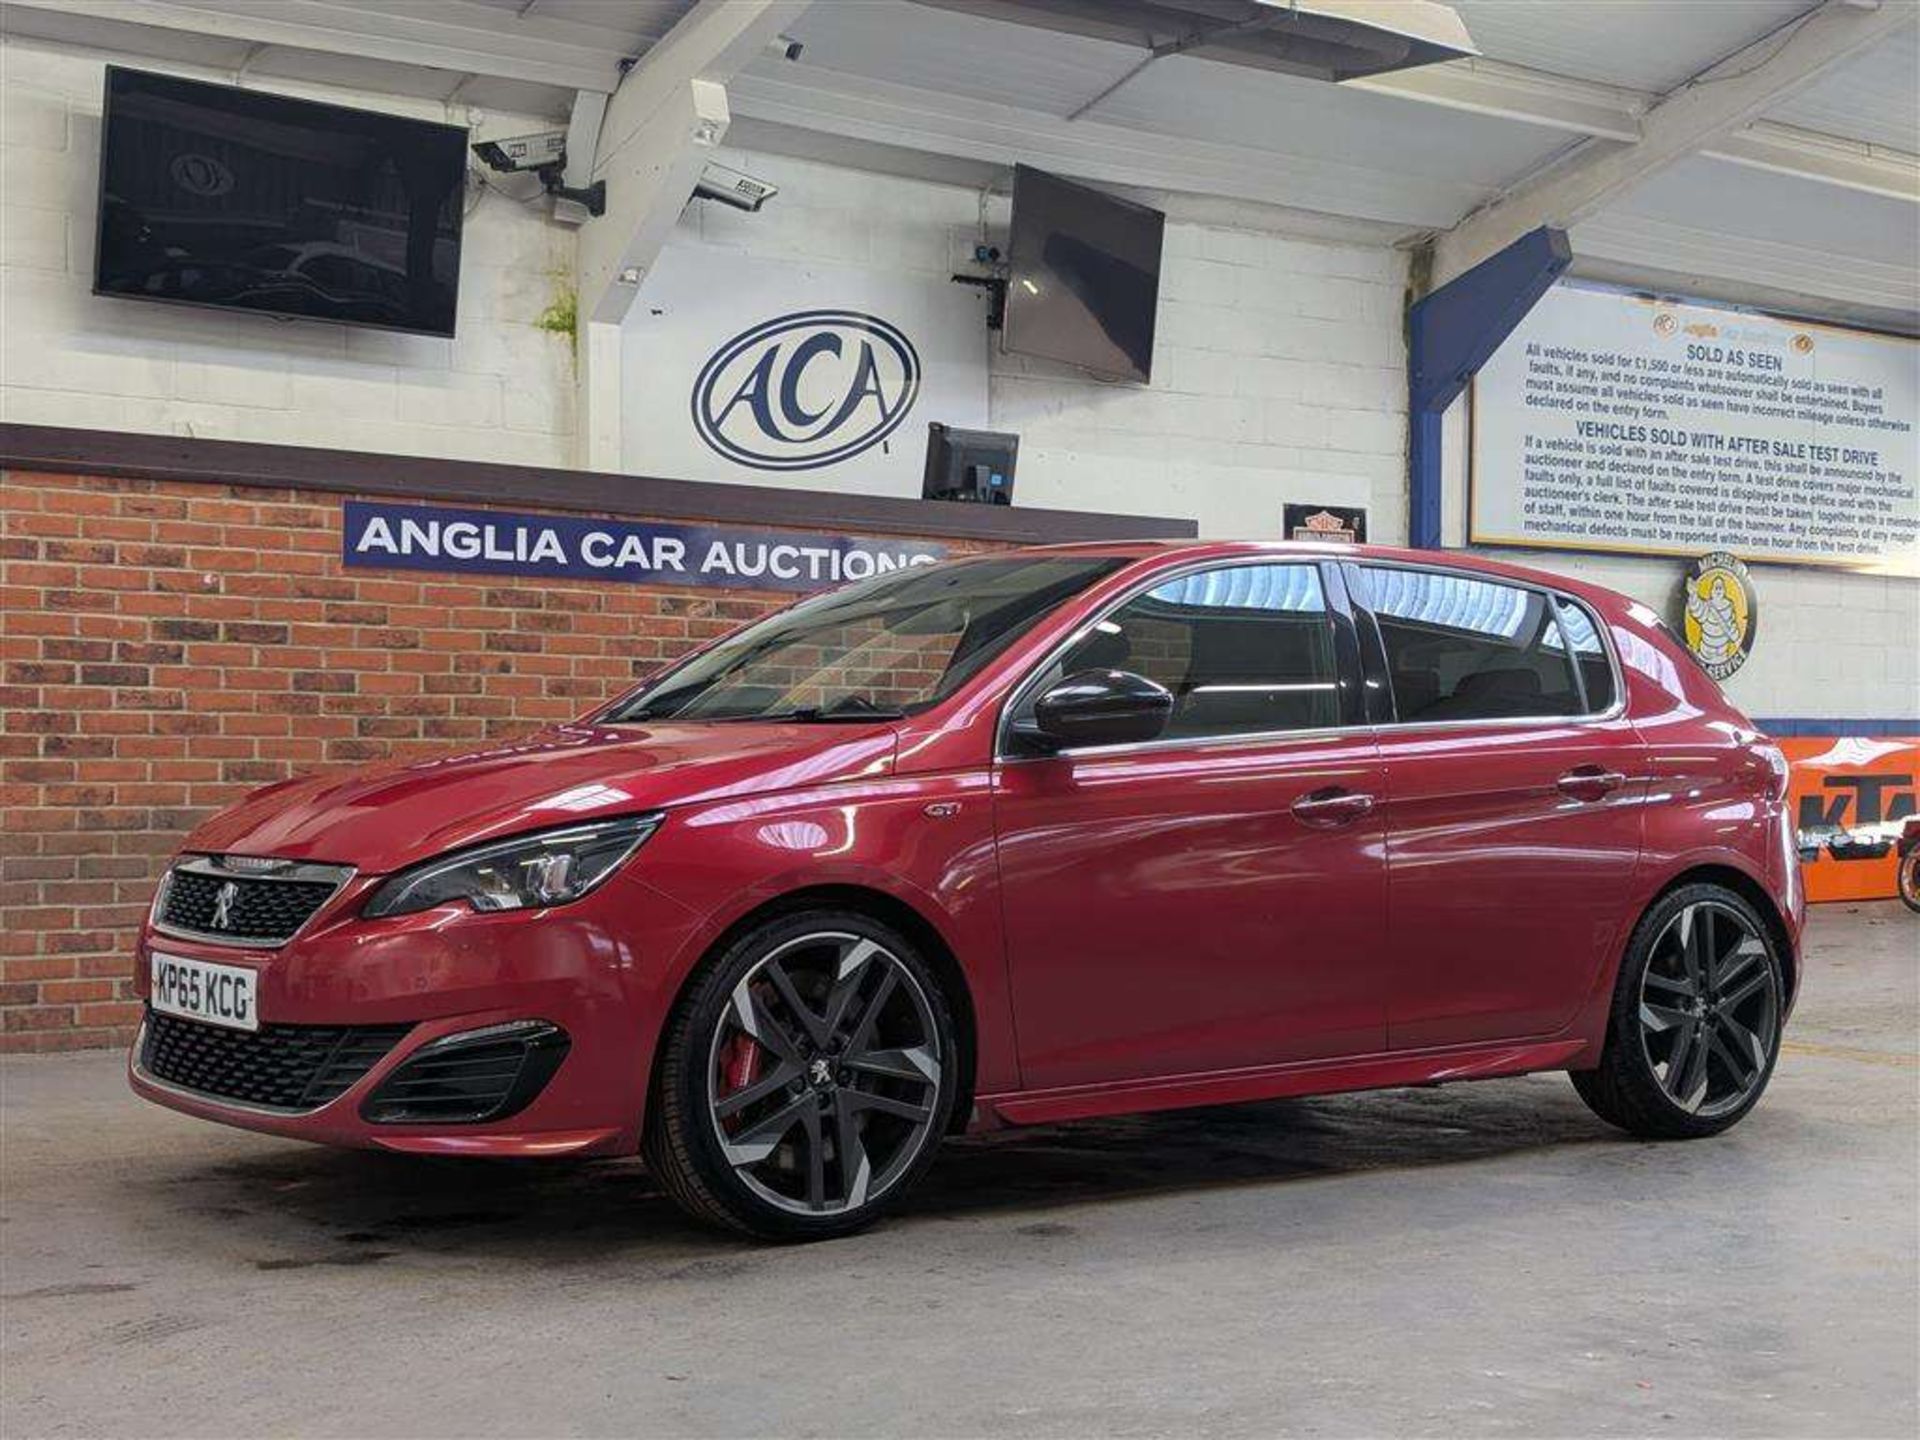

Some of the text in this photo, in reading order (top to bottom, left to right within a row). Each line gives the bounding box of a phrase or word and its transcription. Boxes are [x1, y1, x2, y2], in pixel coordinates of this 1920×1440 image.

[1526, 344, 1540, 356] All
[1544, 345, 1588, 363] vehicles
[1591, 353, 1615, 366] sold
[1617, 356, 1632, 367] for
[1671, 363, 1682, 373] or
[1684, 363, 1705, 377] less
[1707, 368, 1723, 379] are
[1725, 370, 1789, 390] automatically
[1791, 379, 1812, 391] sold
[1814, 383, 1825, 393] as
[1828, 384, 1848, 395] seen
[1851, 386, 1870, 398] with
[1872, 388, 1882, 399] all
[1687, 344, 1782, 371] SOLD AS SEEN
[712, 331, 889, 443] ACA
[1526, 379, 1911, 432] must assume all vehicles sold as seen have incorrect mileage unless otherwise
[1526, 394, 1669, 420] declared on the entry form.
[1529, 361, 1883, 414] faults, if any, and no complaints whatsoever shall be entertained. Buyers
[1525, 435, 1533, 447] If
[1535, 438, 1542, 447] a
[1545, 439, 1583, 452] vehicle
[1587, 443, 1596, 454] is
[1600, 444, 1622, 456] sold
[1625, 447, 1647, 458] with
[1650, 450, 1662, 460] an
[1665, 450, 1687, 462] after
[1691, 453, 1711, 465] sale
[1713, 455, 1733, 466] test
[1764, 459, 1782, 472] this
[1785, 461, 1808, 474] shall
[1809, 463, 1822, 475] be
[1824, 466, 1873, 481] announced
[1875, 471, 1886, 484] by
[1887, 472, 1902, 484] the
[1576, 420, 1878, 467] VEHICLES SOLD WITH AFTER SALE TEST DRIVE
[1525, 454, 1914, 499] auctioneer and declared on the entry form. A test drive covers major mechanical
[1525, 469, 1892, 512] faults only, a full list of faults covered is displayed in the office and with the
[1524, 486, 1590, 502] auctioneer's
[1593, 491, 1622, 505] clerk.
[1626, 493, 1645, 506] The
[1648, 496, 1671, 508] after
[1674, 498, 1694, 511] sale
[1697, 500, 1716, 512] test
[1718, 501, 1743, 514] drive
[1746, 504, 1769, 515] must
[1772, 505, 1783, 517] be
[1818, 510, 1856, 524] together
[1858, 512, 1877, 524] with
[1879, 515, 1885, 525] a
[1524, 502, 1915, 544] of staff, within one hour from the fall of the hammer. Any complaints of any major
[356, 516, 568, 565] ANGLIA
[580, 531, 686, 571] CAR
[1524, 518, 1882, 555] mechanical defects must be reported within one hour from the test drive.
[158, 961, 247, 1020] KP65 KCG
